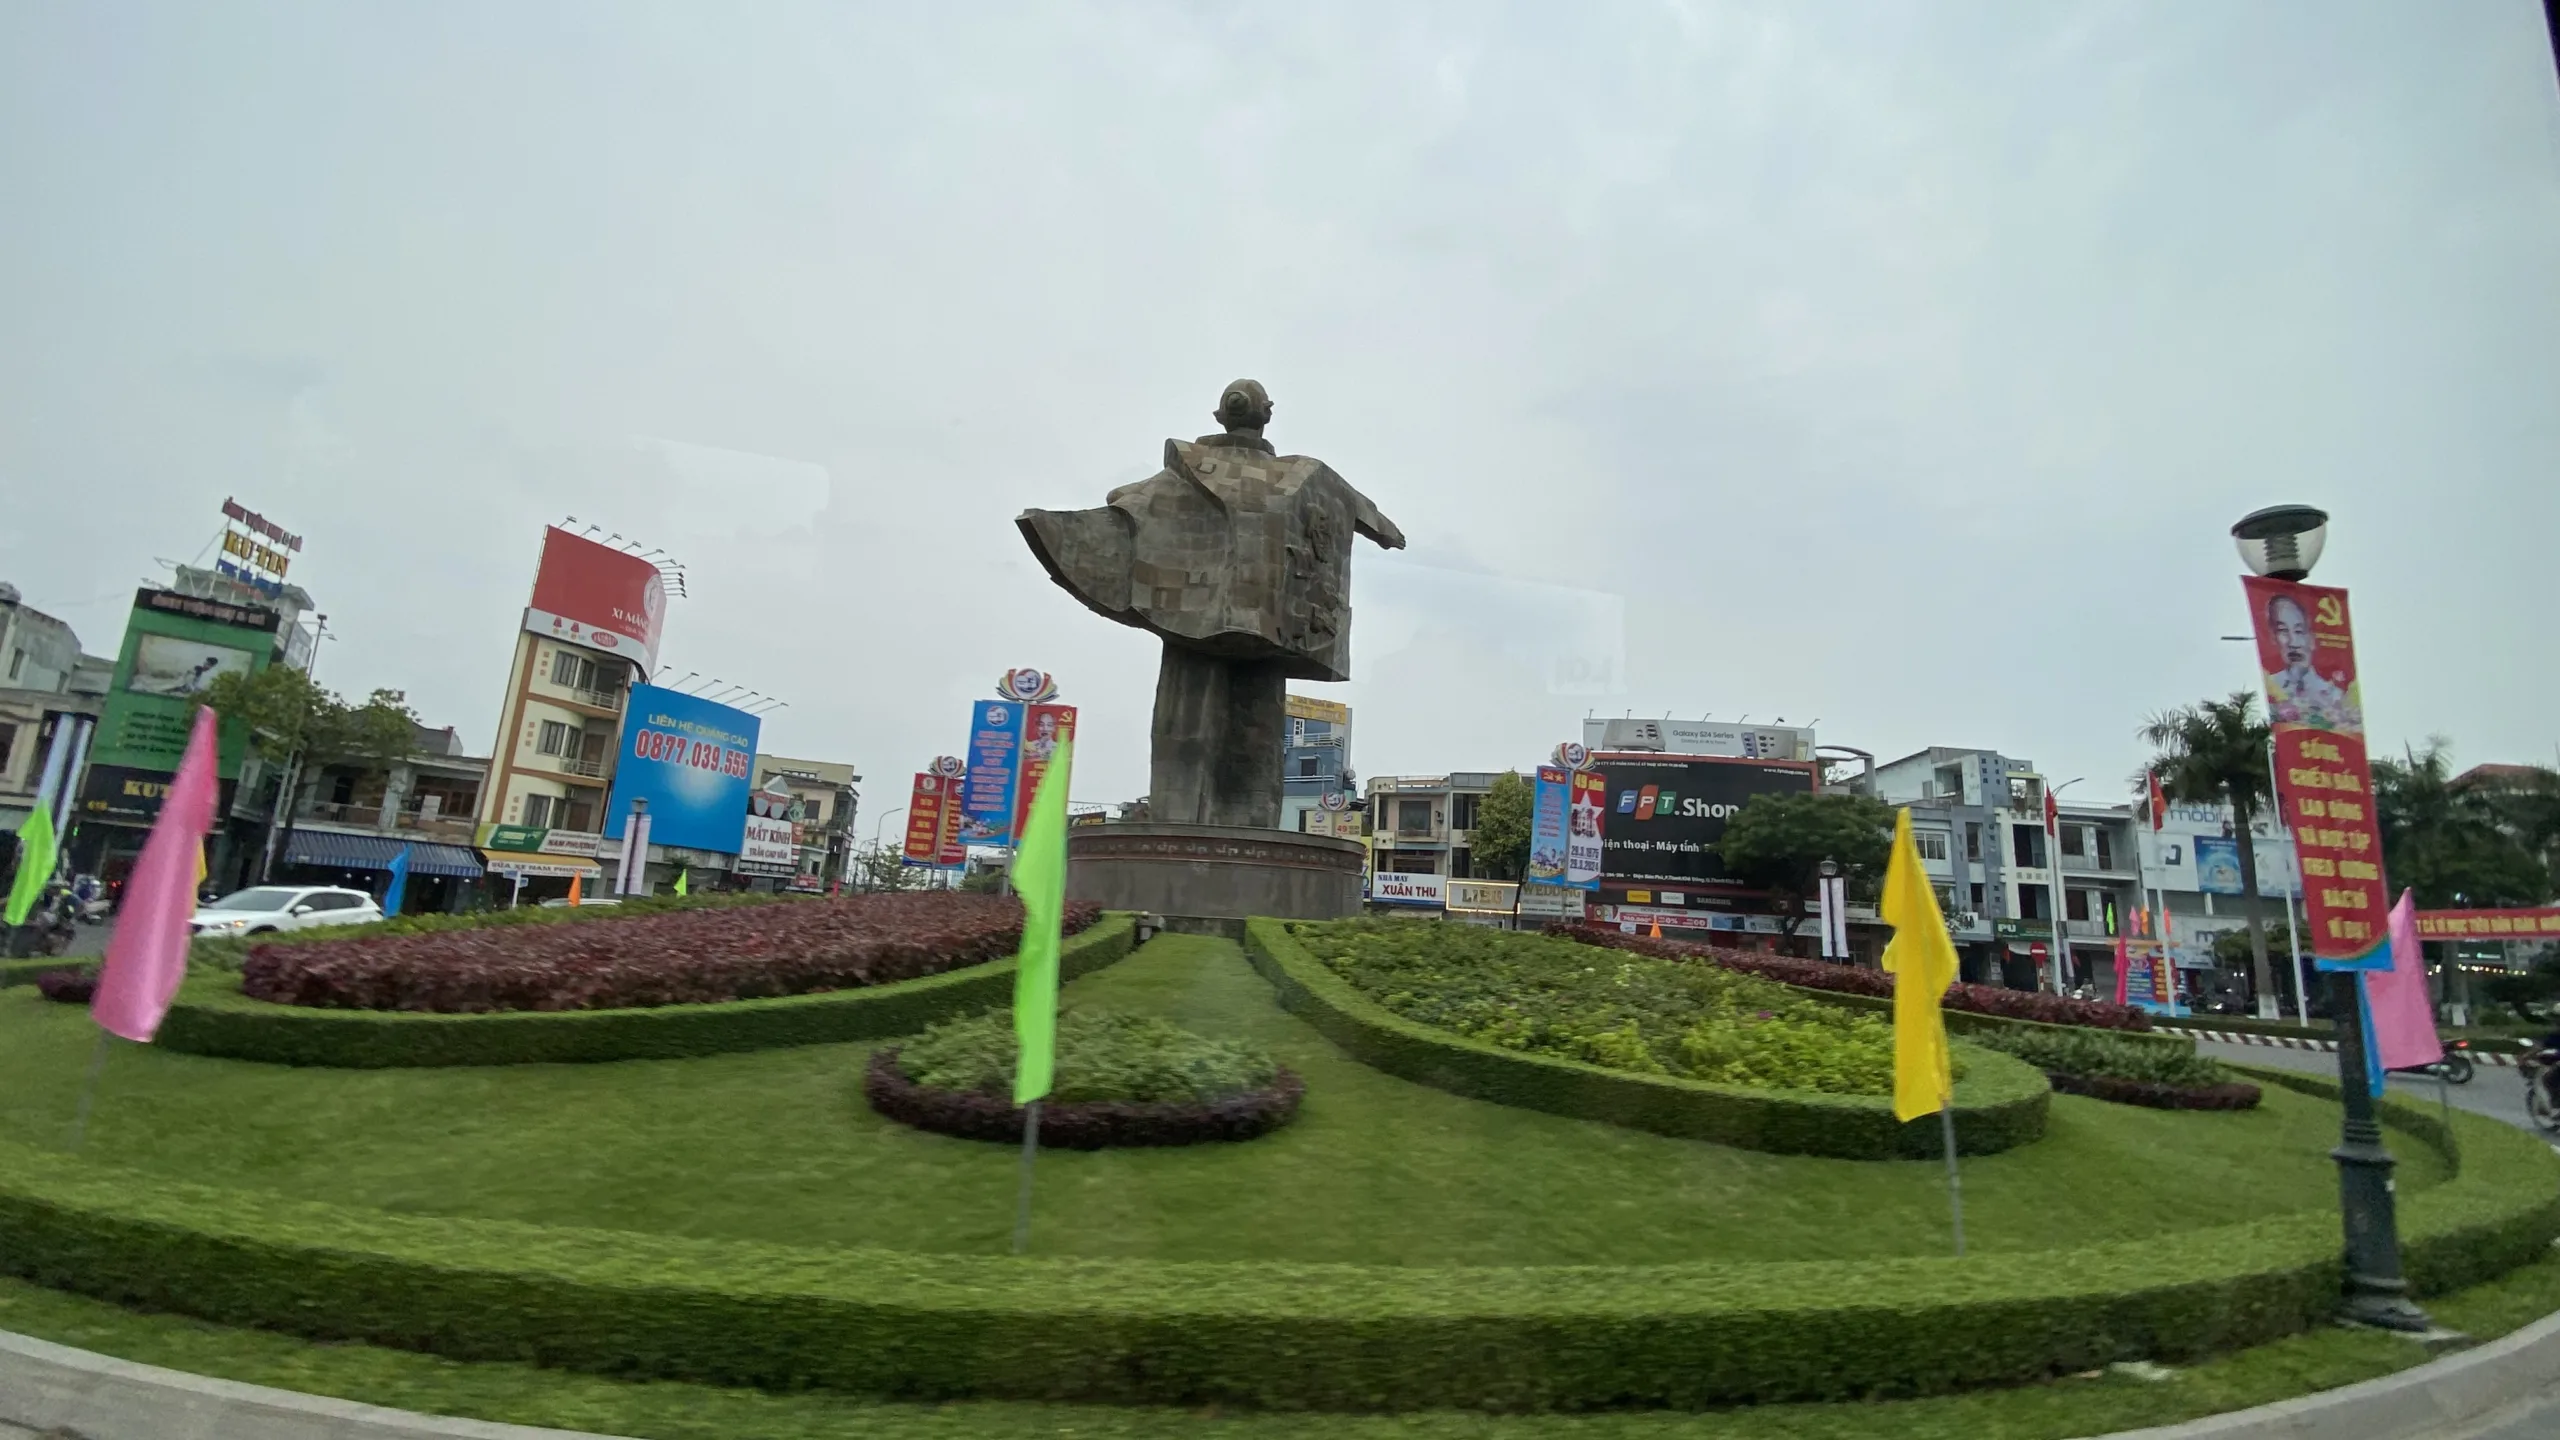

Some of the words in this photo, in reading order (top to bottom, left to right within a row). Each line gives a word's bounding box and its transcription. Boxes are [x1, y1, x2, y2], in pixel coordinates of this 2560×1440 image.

[223, 529, 290, 578] KUTIN
[612, 607, 623, 620] XI
[648, 713, 677, 728] LIÊN
[679, 720, 693, 733] HỆ
[695, 725, 730, 742] QUẢNG
[730, 734, 748, 748] CÁO
[1672, 730, 1698, 738] Galaxy
[1700, 730, 1712, 738] S24
[1713, 731, 1735, 739] Series
[635, 729, 749, 779] 0877.039.555
[2298, 798, 2325, 816] LAO
[746, 821, 768, 841] MẮT
[769, 826, 790, 845] KÍNH
[1336, 825, 1348, 833] 49
[1602, 839, 1620, 851] iện
[1622, 838, 1650, 852] thoại
[1656, 841, 1678, 853] Máy
[1679, 839, 1700, 853] tính
[1382, 882, 1412, 896] XUÂN
[1415, 886, 1436, 897] THU
[1523, 884, 1580, 898] WEDDING
[1696, 896, 1732, 906] SAMSUNG
[1997, 923, 2017, 933] PU
